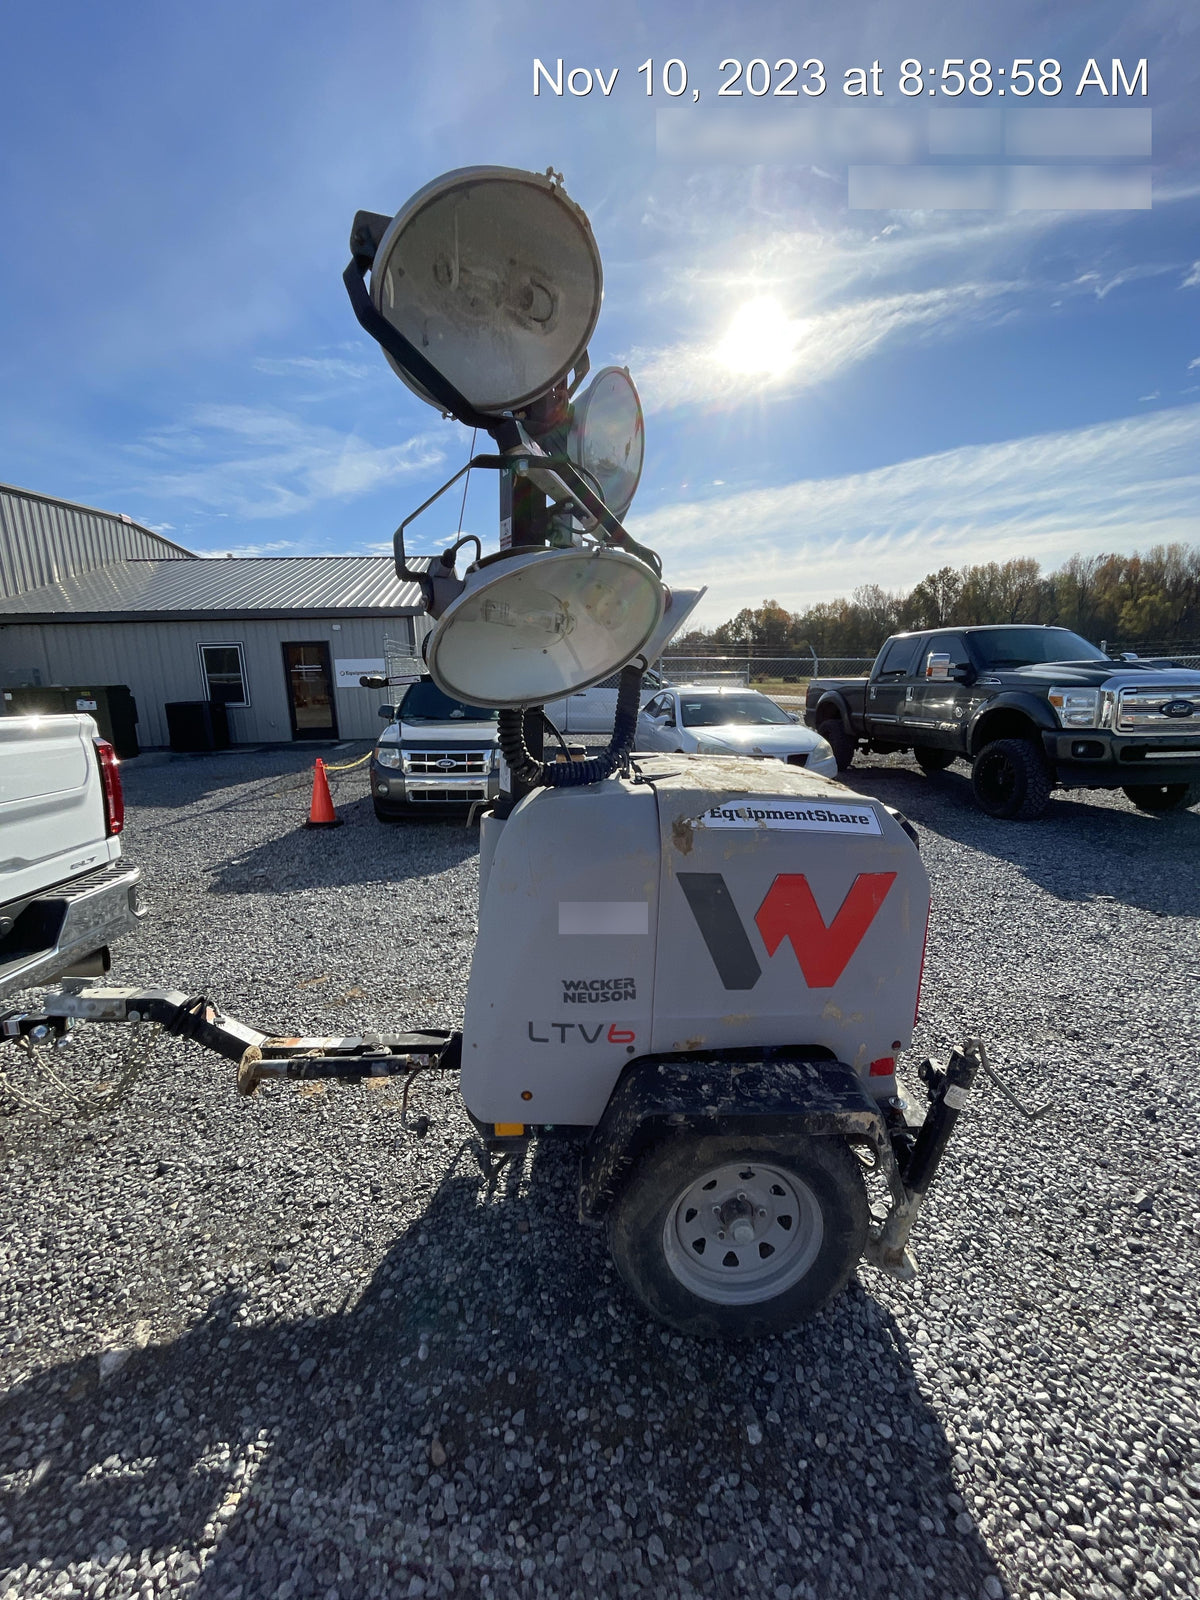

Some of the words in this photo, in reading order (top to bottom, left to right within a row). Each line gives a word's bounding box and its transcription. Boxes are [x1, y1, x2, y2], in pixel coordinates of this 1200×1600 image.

[561, 978, 636, 992] WACKER
[563, 989, 637, 1004] NEUSON
[528, 1021, 636, 1044] LTV6
